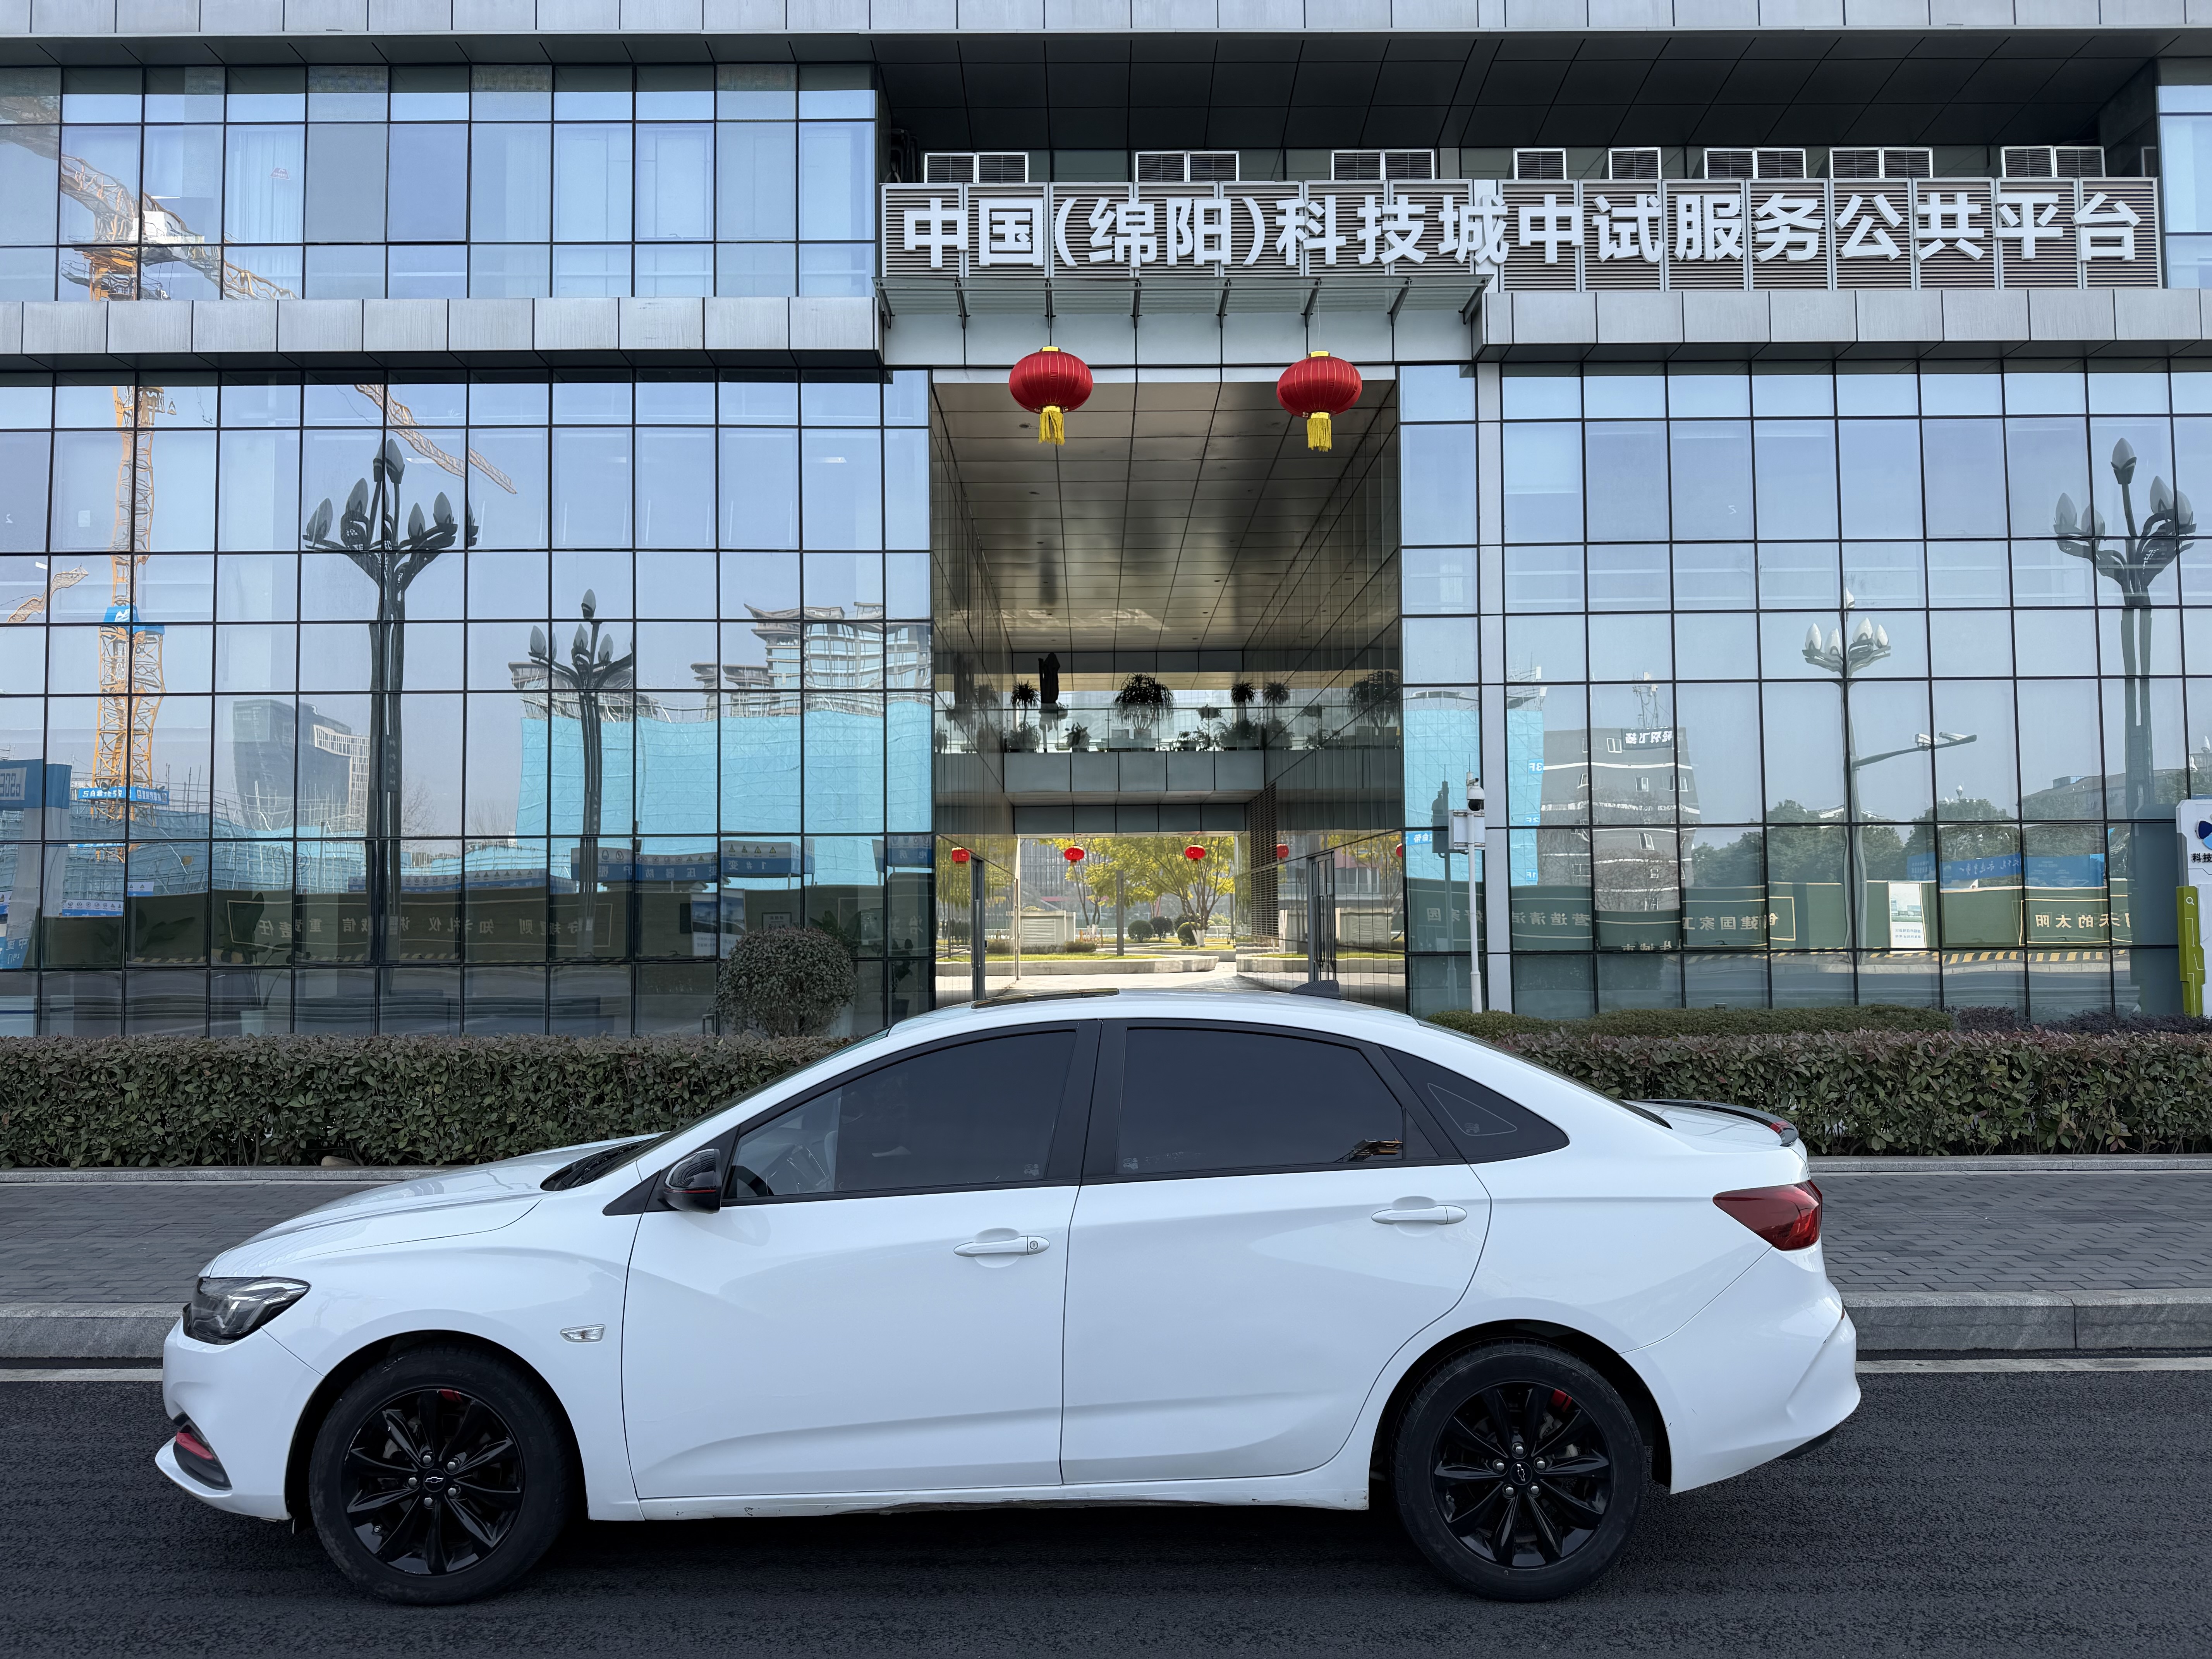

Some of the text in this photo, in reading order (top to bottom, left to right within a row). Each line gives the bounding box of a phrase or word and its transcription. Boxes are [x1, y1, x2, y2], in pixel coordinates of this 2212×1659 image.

[903, 191, 2142, 268] 中国(绵阳)科技城中试服务公共平台
[2191, 853, 2212, 863] 科技
